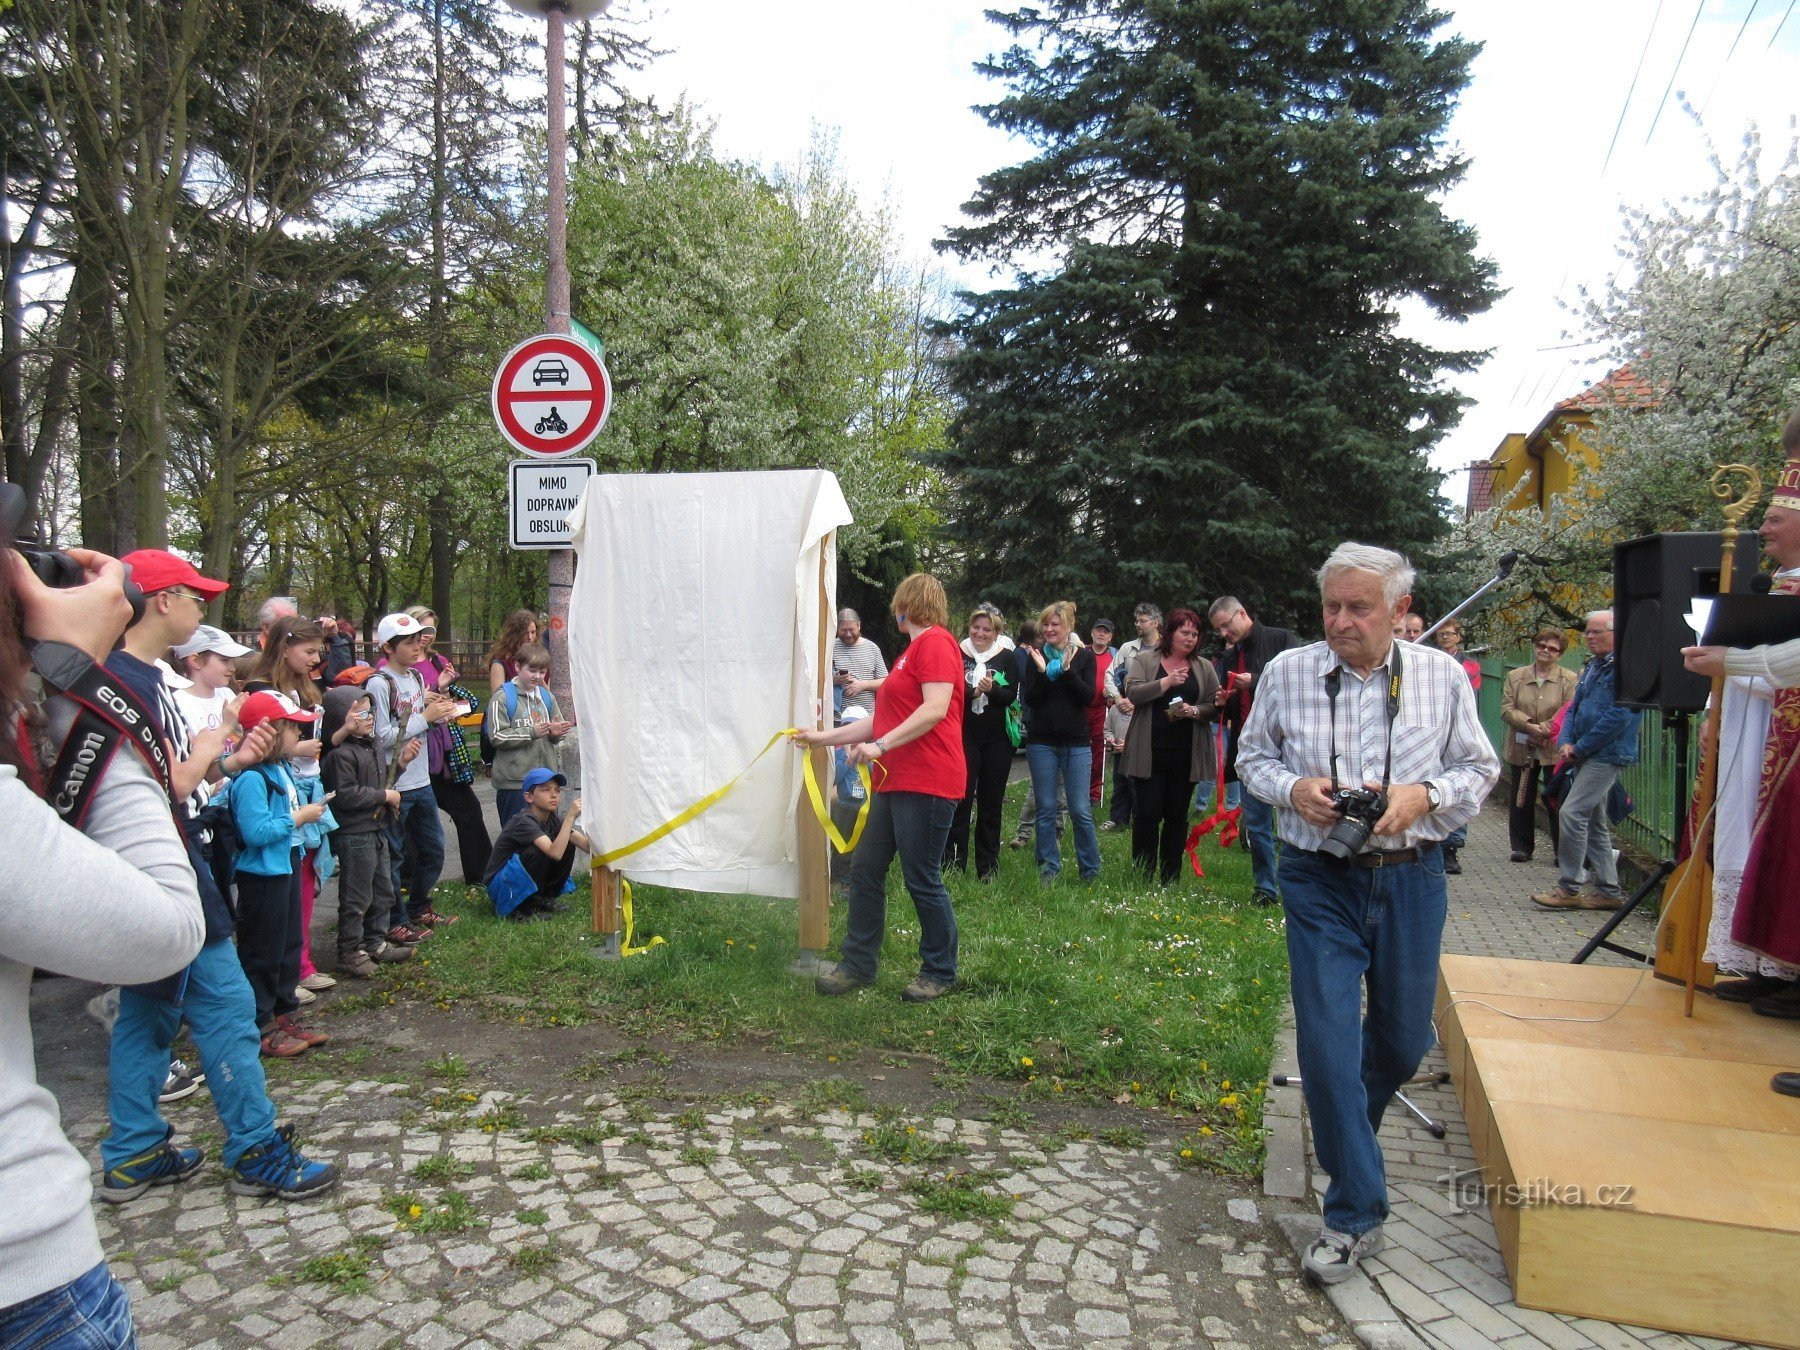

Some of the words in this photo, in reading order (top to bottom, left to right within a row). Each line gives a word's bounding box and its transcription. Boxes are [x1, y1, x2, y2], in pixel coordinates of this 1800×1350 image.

[539, 476, 567, 490] MIMO
[527, 494, 578, 511] DOPRAVNÍ
[529, 519, 570, 533] OBSLUH
[1390, 675, 1399, 698] Nikon
[96, 685, 141, 725] EOS
[55, 732, 106, 814] Canon
